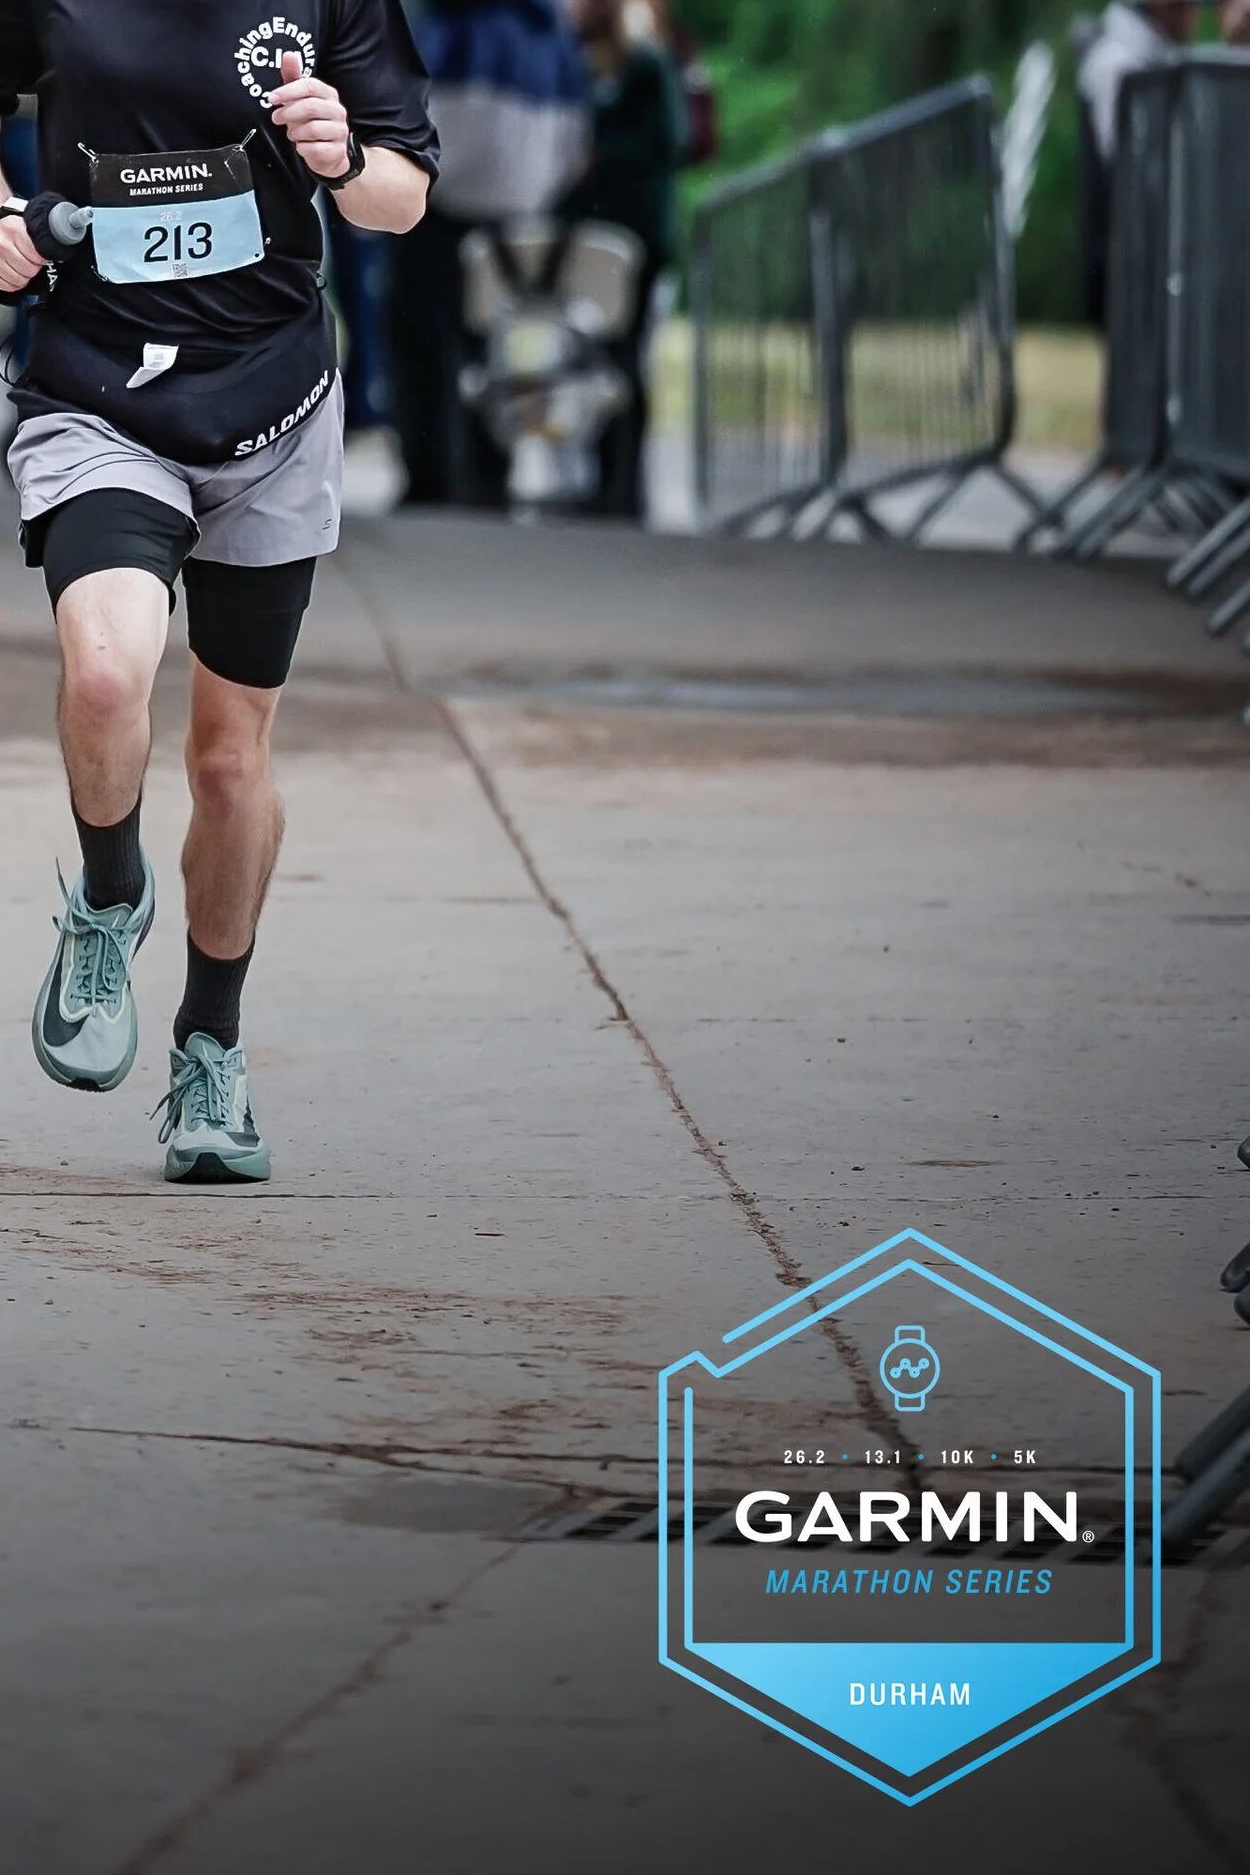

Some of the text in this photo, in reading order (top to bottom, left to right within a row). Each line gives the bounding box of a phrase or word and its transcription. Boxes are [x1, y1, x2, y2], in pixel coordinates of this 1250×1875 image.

[129, 183, 204, 196] MARATHON SERIES
[160, 210, 182, 222] 26.2
[144, 222, 213, 263] 213
[234, 370, 329, 456] SALOMON
